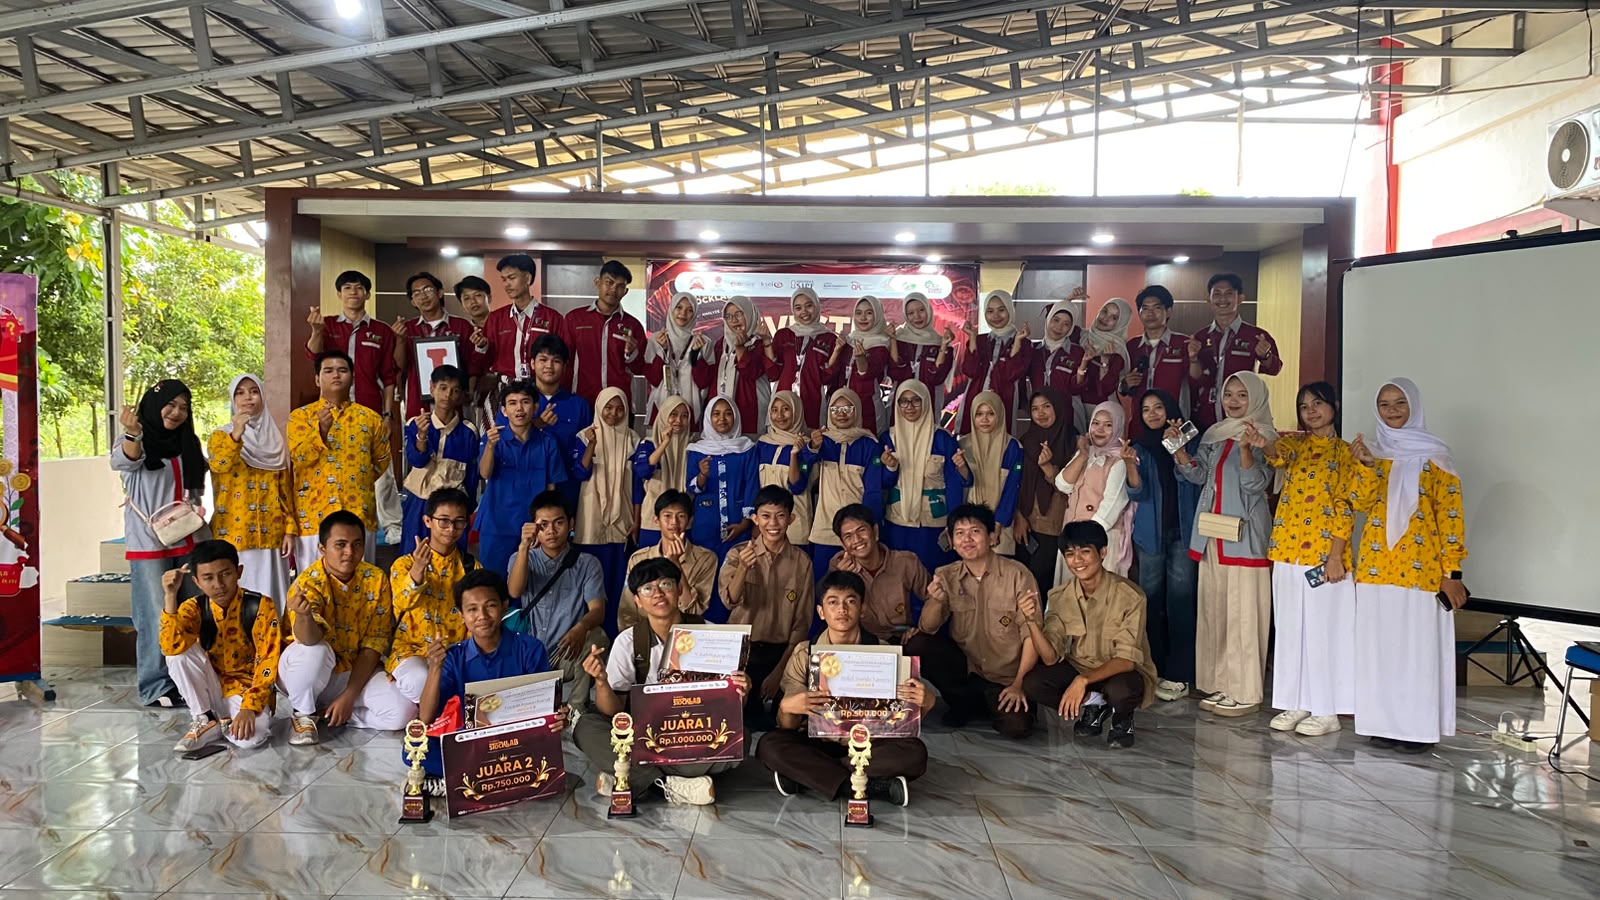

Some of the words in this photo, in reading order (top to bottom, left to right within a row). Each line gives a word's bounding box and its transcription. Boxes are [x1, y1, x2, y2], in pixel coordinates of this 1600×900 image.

[660, 718, 704, 731] JUARA
[706, 716, 712, 728] 1
[659, 734, 713, 746] Rp.1.000.000
[476, 759, 523, 779] JUARA
[524, 756, 533, 769] 2
[481, 774, 531, 792] Rp.750.000
